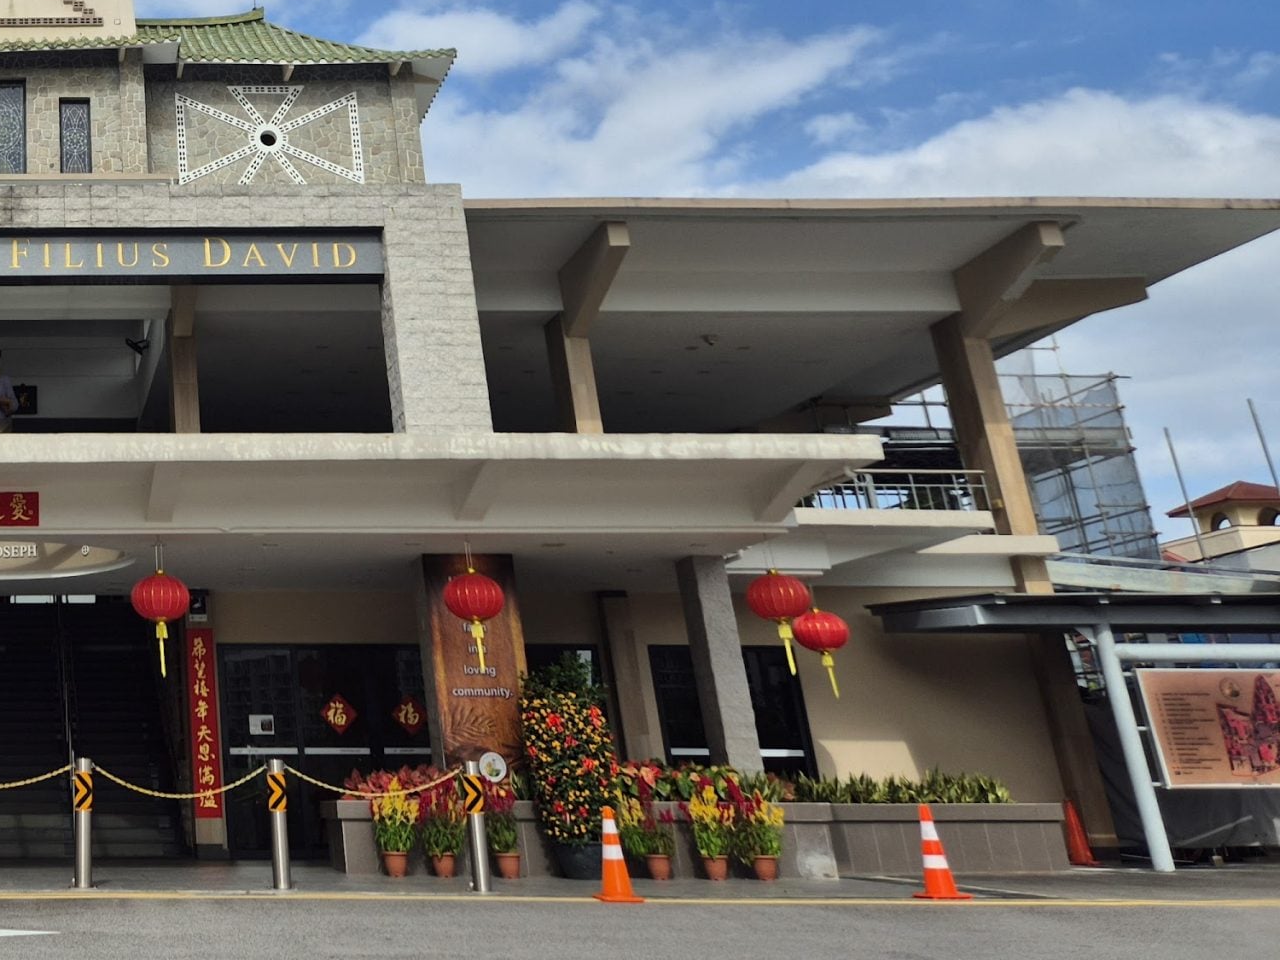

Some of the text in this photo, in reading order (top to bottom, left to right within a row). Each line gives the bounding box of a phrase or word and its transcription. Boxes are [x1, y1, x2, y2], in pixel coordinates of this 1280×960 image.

[9, 239, 170, 269] FILIUS
[202, 237, 357, 269] DAVID
[463, 664, 497, 678] lovng
[452, 687, 513, 698] community.
[326, 701, 347, 726] 福
[398, 702, 420, 726] 福
